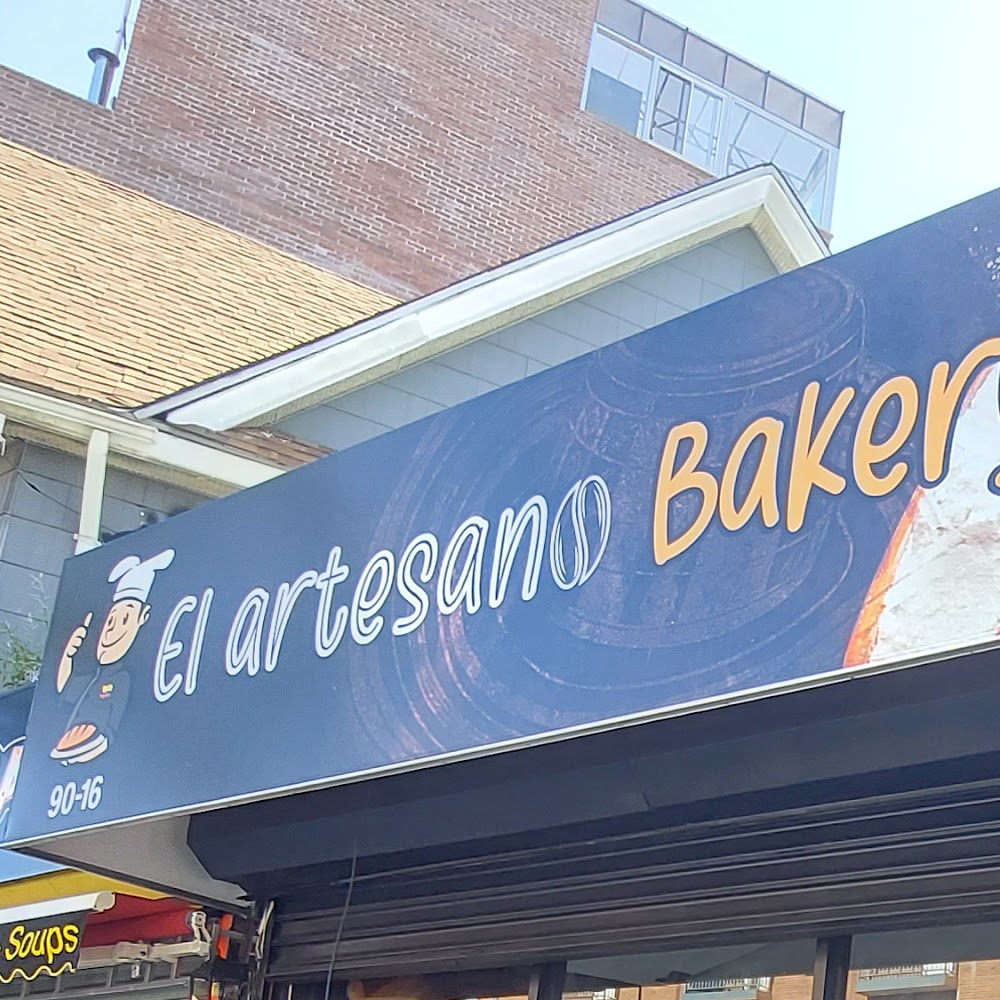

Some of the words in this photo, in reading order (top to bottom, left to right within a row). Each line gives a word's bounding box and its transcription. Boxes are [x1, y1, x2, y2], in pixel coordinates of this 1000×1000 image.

[153, 588, 214, 702] El
[226, 475, 611, 676] artesano
[47, 775, 104, 818] 90-16
[4, 924, 80, 964] Soups
